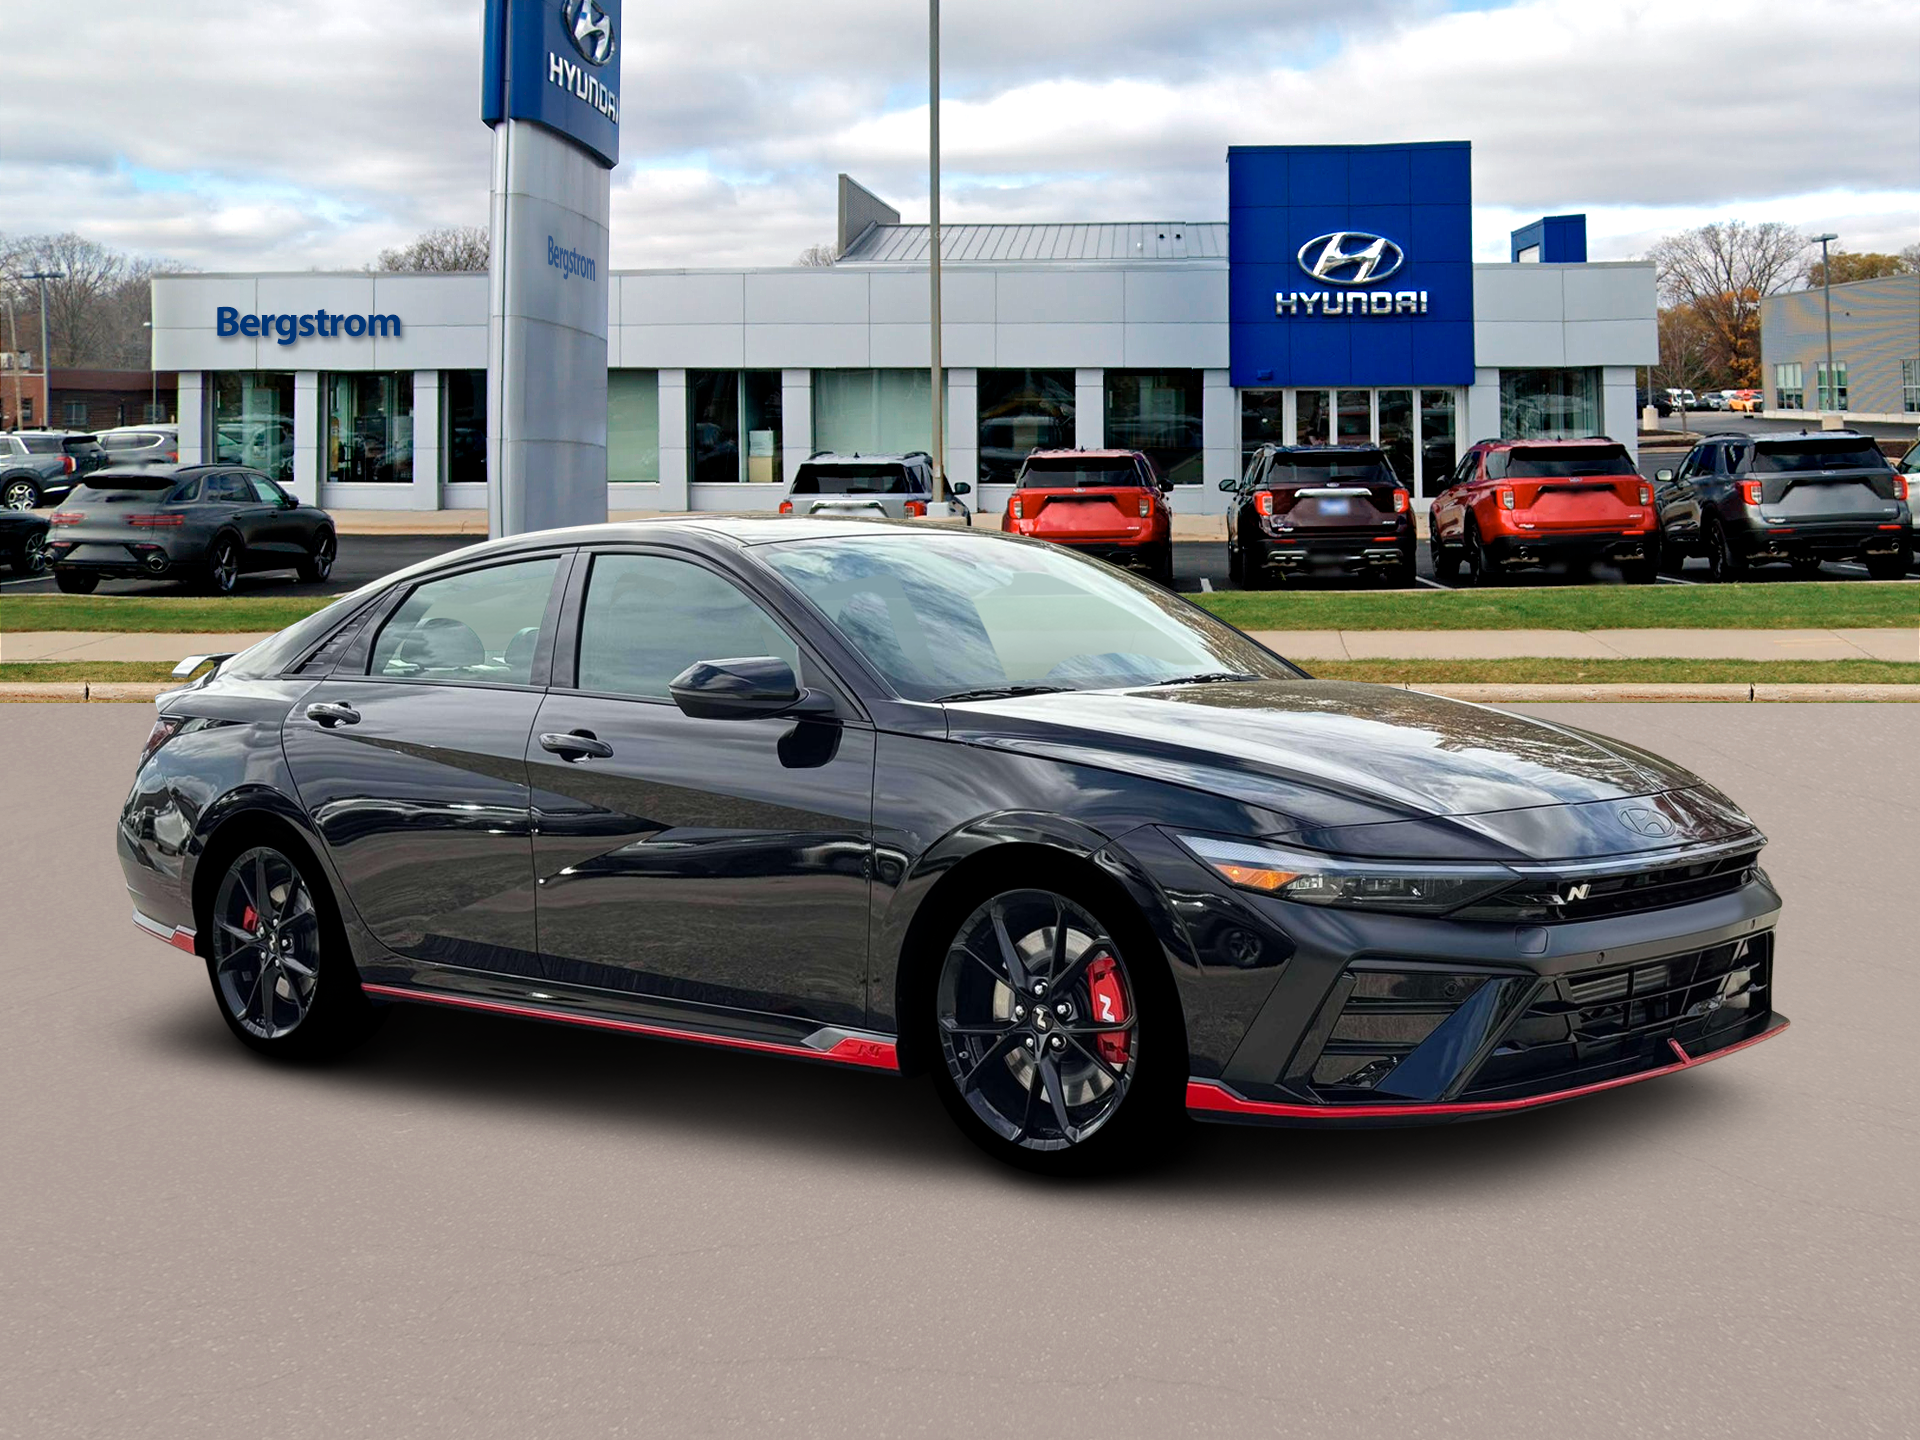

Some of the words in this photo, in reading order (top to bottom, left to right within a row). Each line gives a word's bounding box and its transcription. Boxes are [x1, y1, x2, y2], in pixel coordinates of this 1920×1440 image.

[549, 51, 619, 124] HYUNDAI
[547, 235, 596, 281] Bergstrom
[1275, 290, 1428, 315] HYUNDAI
[216, 306, 401, 346] Bergstrom
